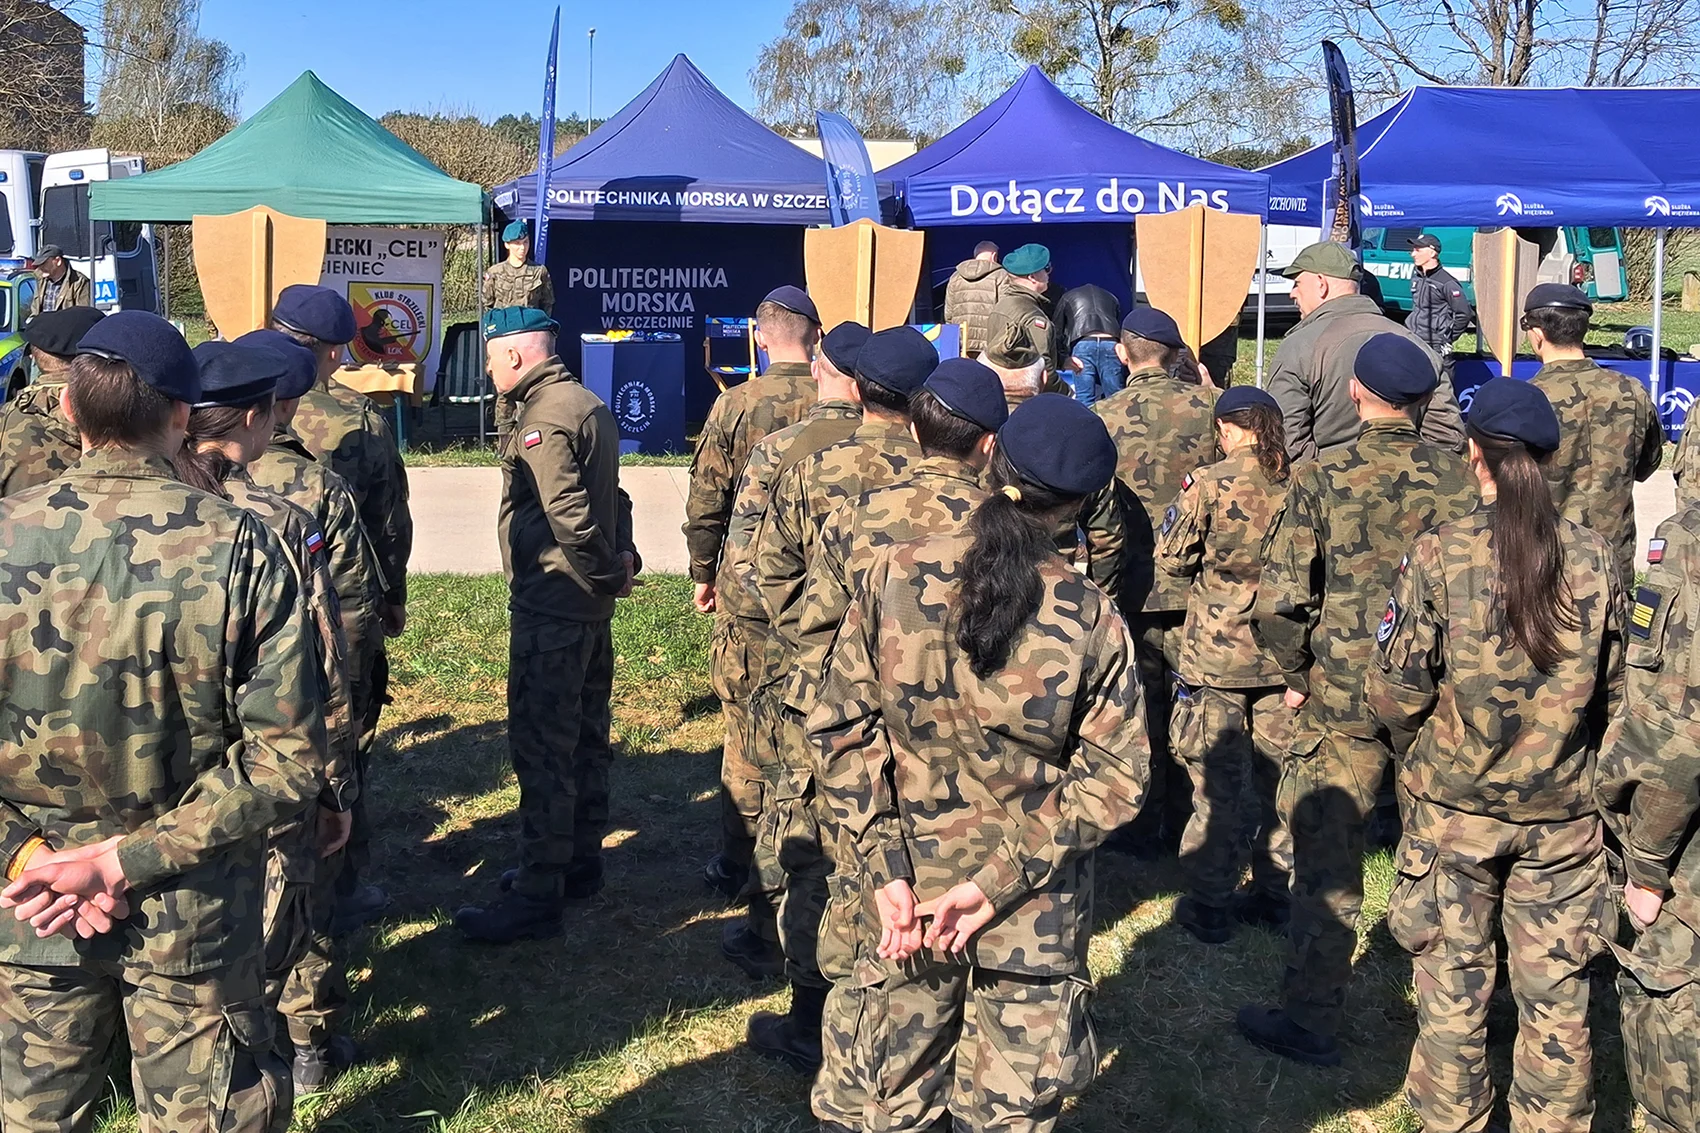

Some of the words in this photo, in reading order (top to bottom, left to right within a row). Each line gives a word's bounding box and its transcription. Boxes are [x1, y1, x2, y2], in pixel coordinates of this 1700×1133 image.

[547, 189, 672, 206] POLITECHNIKA
[675, 191, 749, 207] MORSKA
[752, 193, 769, 208] W
[950, 179, 1085, 222] Dołącz
[1095, 177, 1145, 213] do
[1158, 182, 1229, 214] Nas
[326, 237, 373, 256] LECKI
[321, 260, 385, 276] IENIEC
[568, 267, 729, 289] POLITECHNIKA
[374, 290, 394, 301] KLUB
[397, 293, 426, 330] STRZELECKI
[602, 292, 695, 313] MORSKA
[390, 319, 412, 330] CEL
[600, 316, 615, 329] W
[618, 316, 694, 329] SZCZECINIE
[615, 381, 645, 413] POLITECHNIKA
